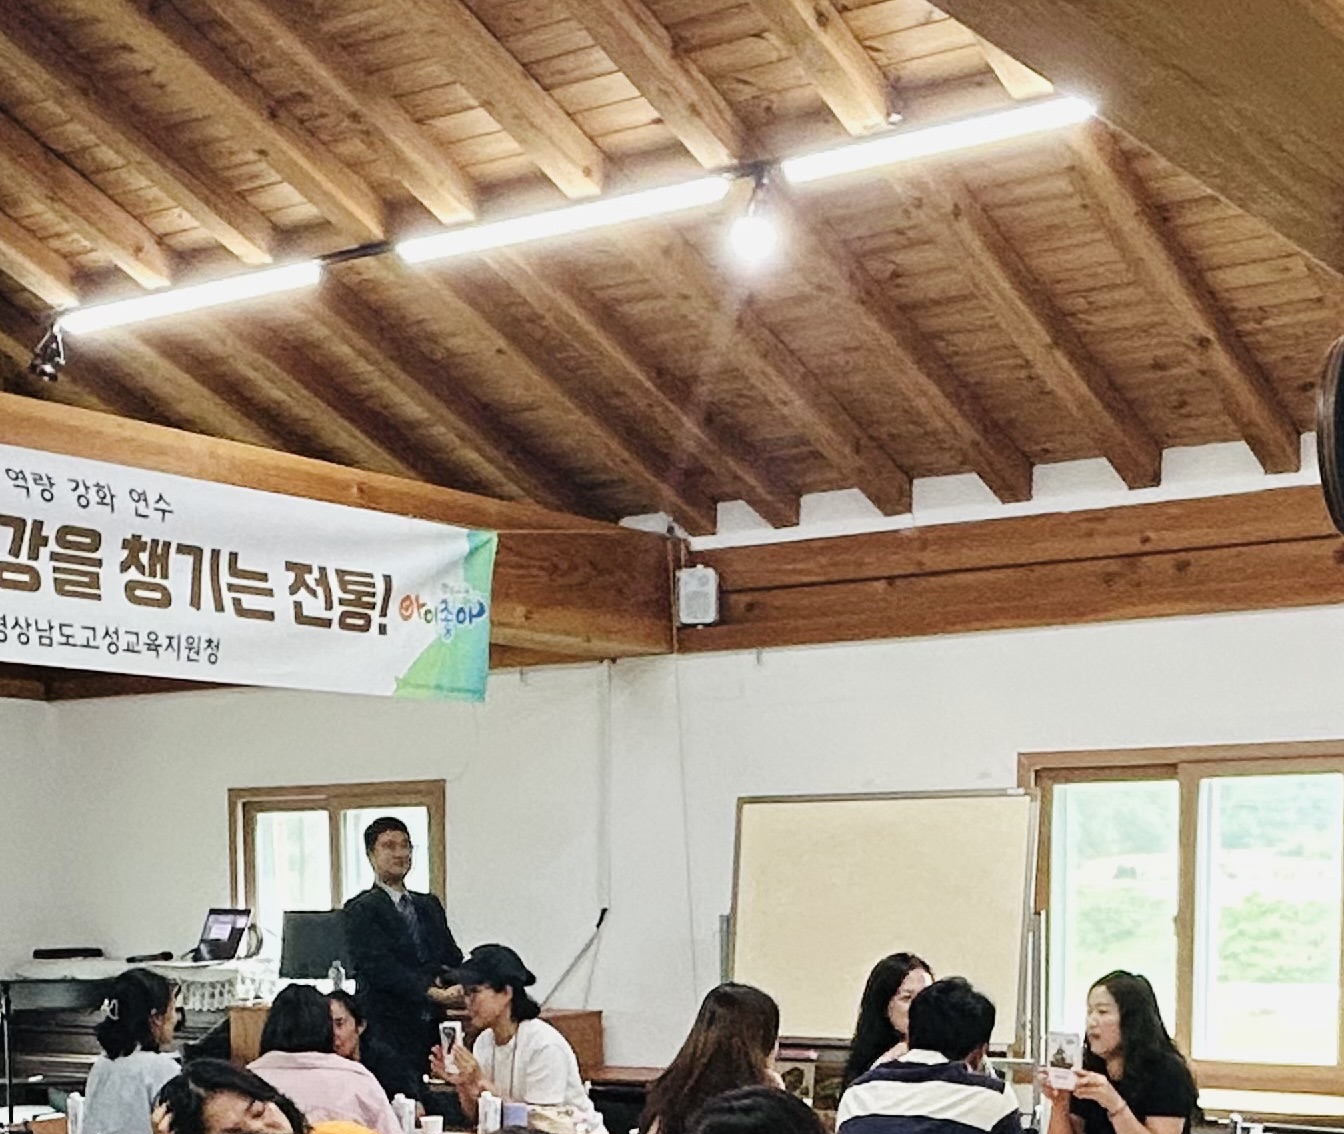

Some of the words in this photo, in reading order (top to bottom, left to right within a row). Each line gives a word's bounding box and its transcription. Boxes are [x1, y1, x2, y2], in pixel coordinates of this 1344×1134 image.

[4, 467, 56, 503] 역량
[67, 477, 116, 513] 강화
[129, 487, 174, 523] 연수
[119, 533, 276, 622] 챙기는
[284, 560, 393, 636] 전통!
[398, 593, 486, 640] 아이좋아
